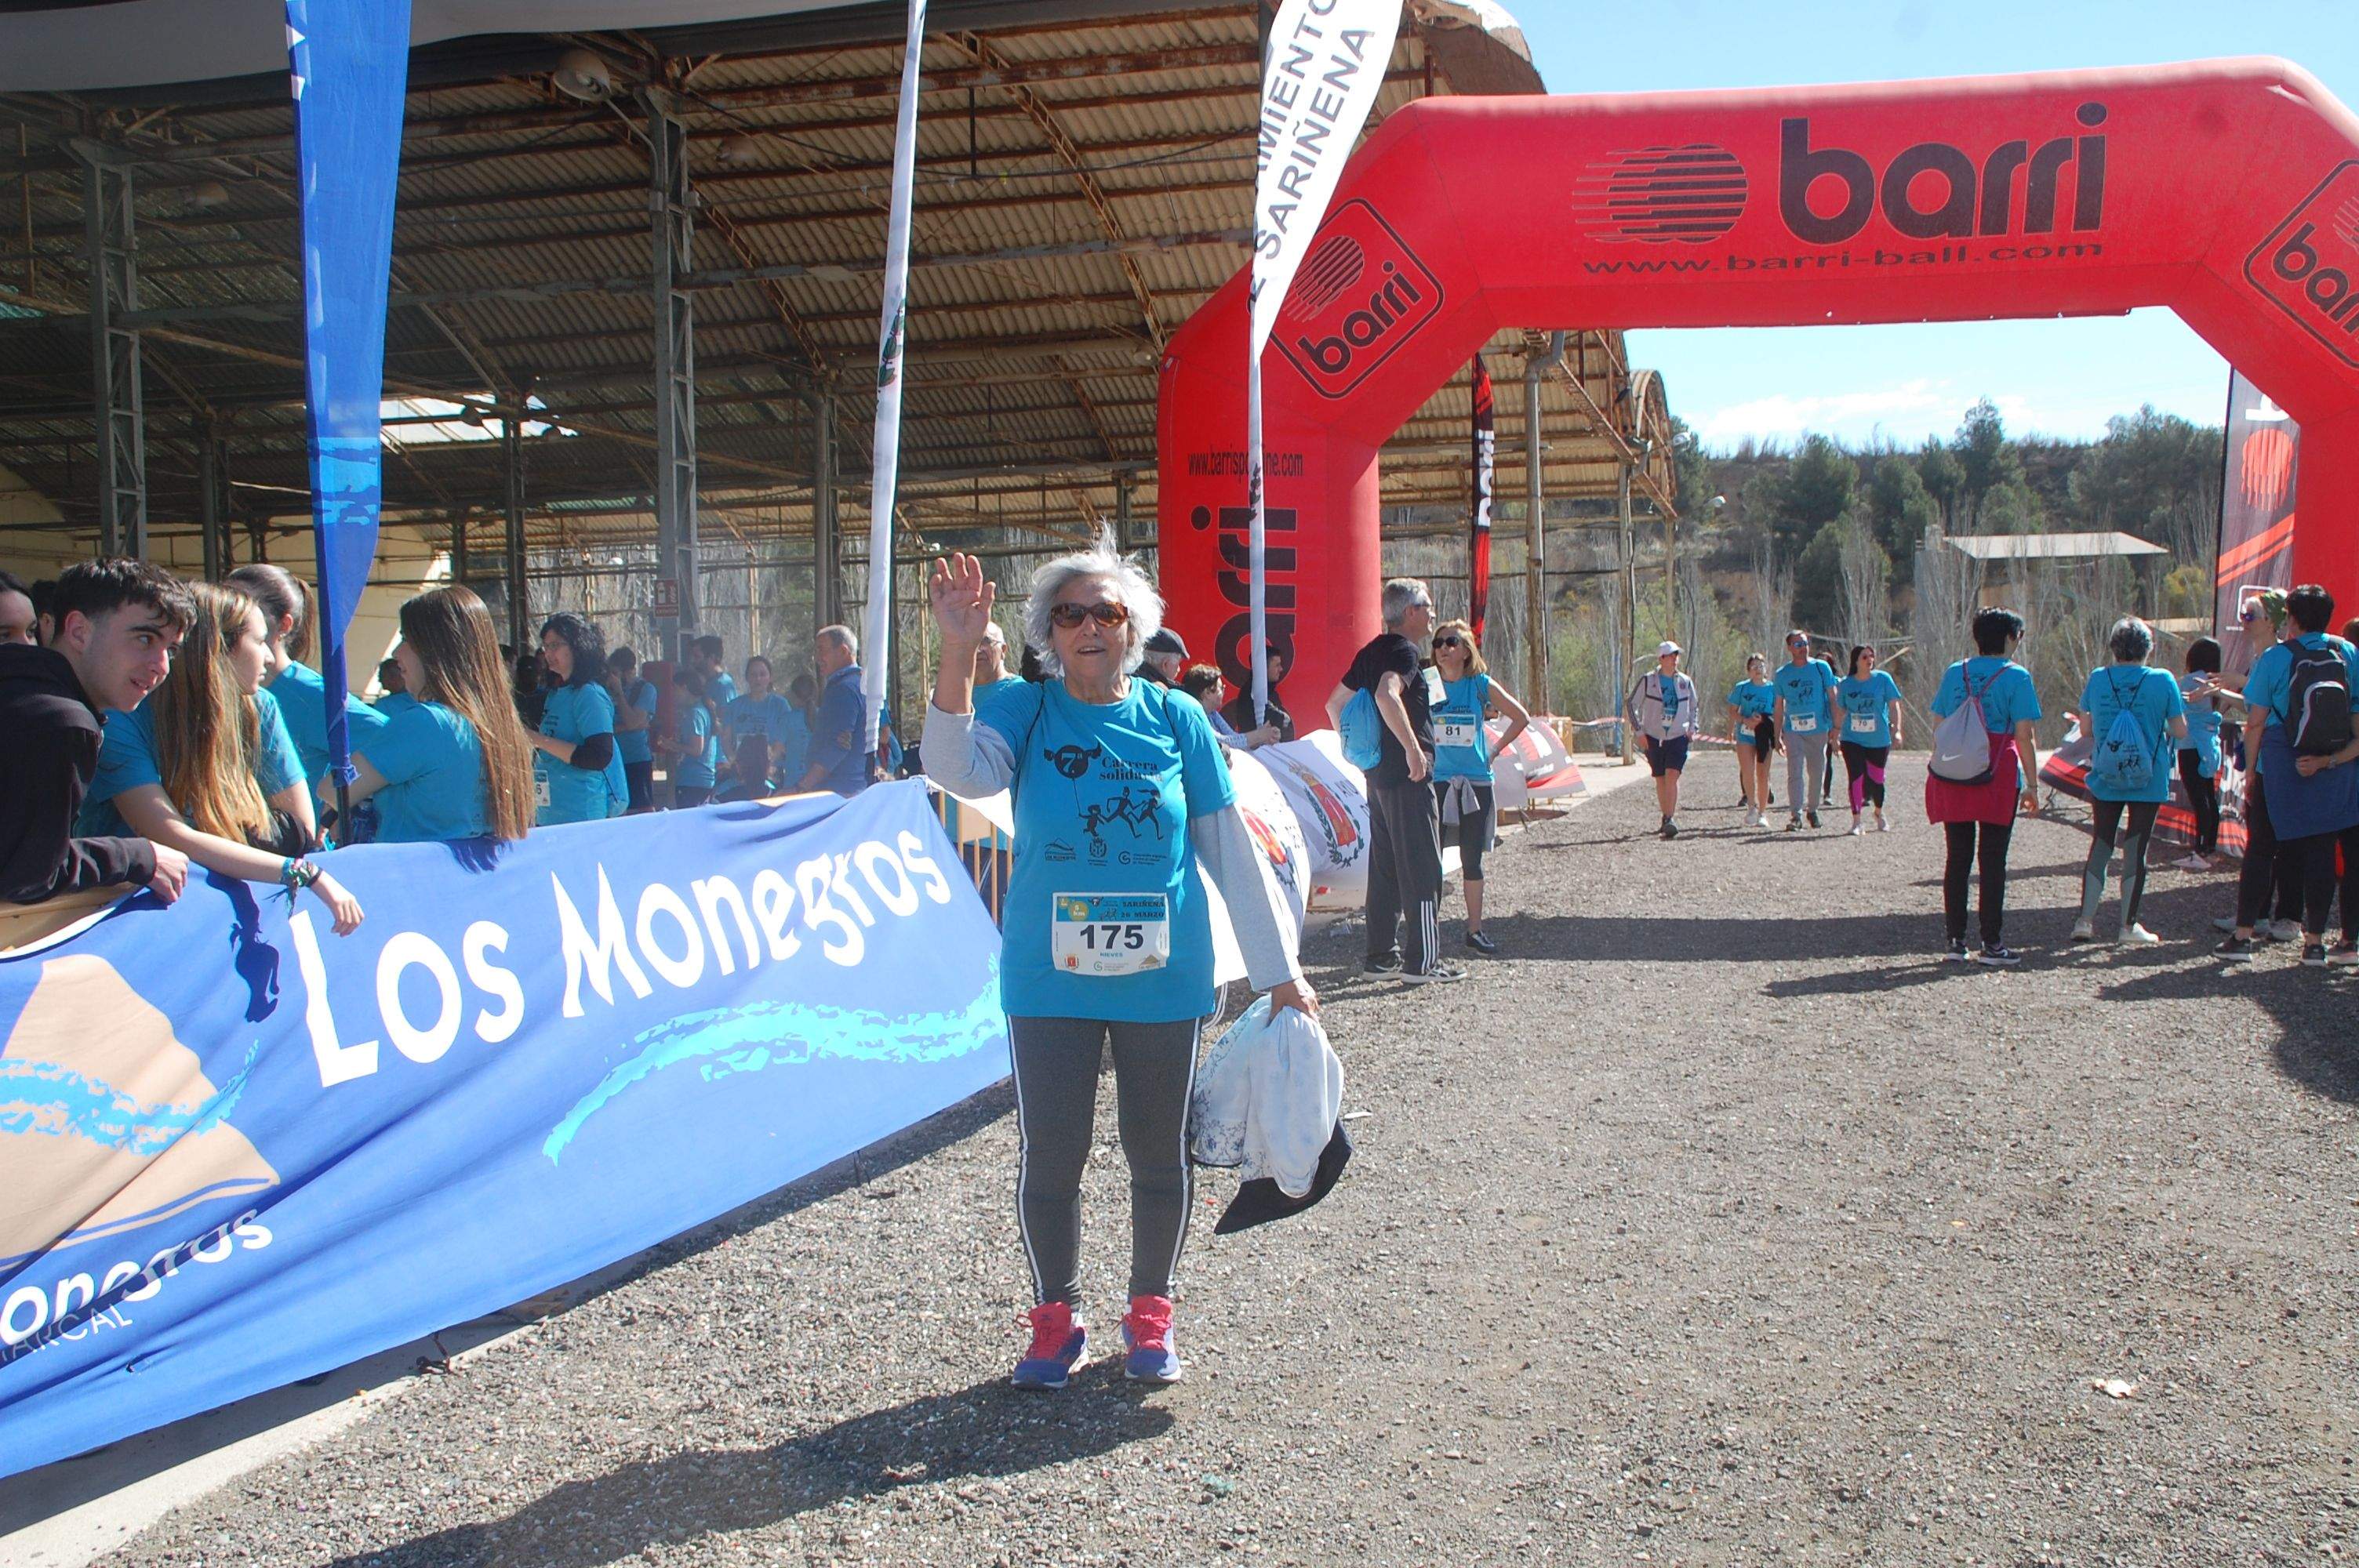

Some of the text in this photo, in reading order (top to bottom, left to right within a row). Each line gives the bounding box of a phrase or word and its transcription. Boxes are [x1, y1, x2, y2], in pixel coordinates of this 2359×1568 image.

[1255, 29, 1375, 260] SARIÑENA
[1779, 102, 2109, 245] barri
[1583, 241, 2103, 274] www.barri-ball.com
[2272, 221, 2359, 343] bar
[1296, 260, 1423, 375] barri
[1190, 504, 1297, 742] arri
[1102, 757, 1158, 771] Carrera
[1445, 725, 1460, 735] 81
[551, 830, 951, 1018] Monegros
[1080, 924, 1144, 949] 175
[2, 1303, 133, 1362] ARCAL
